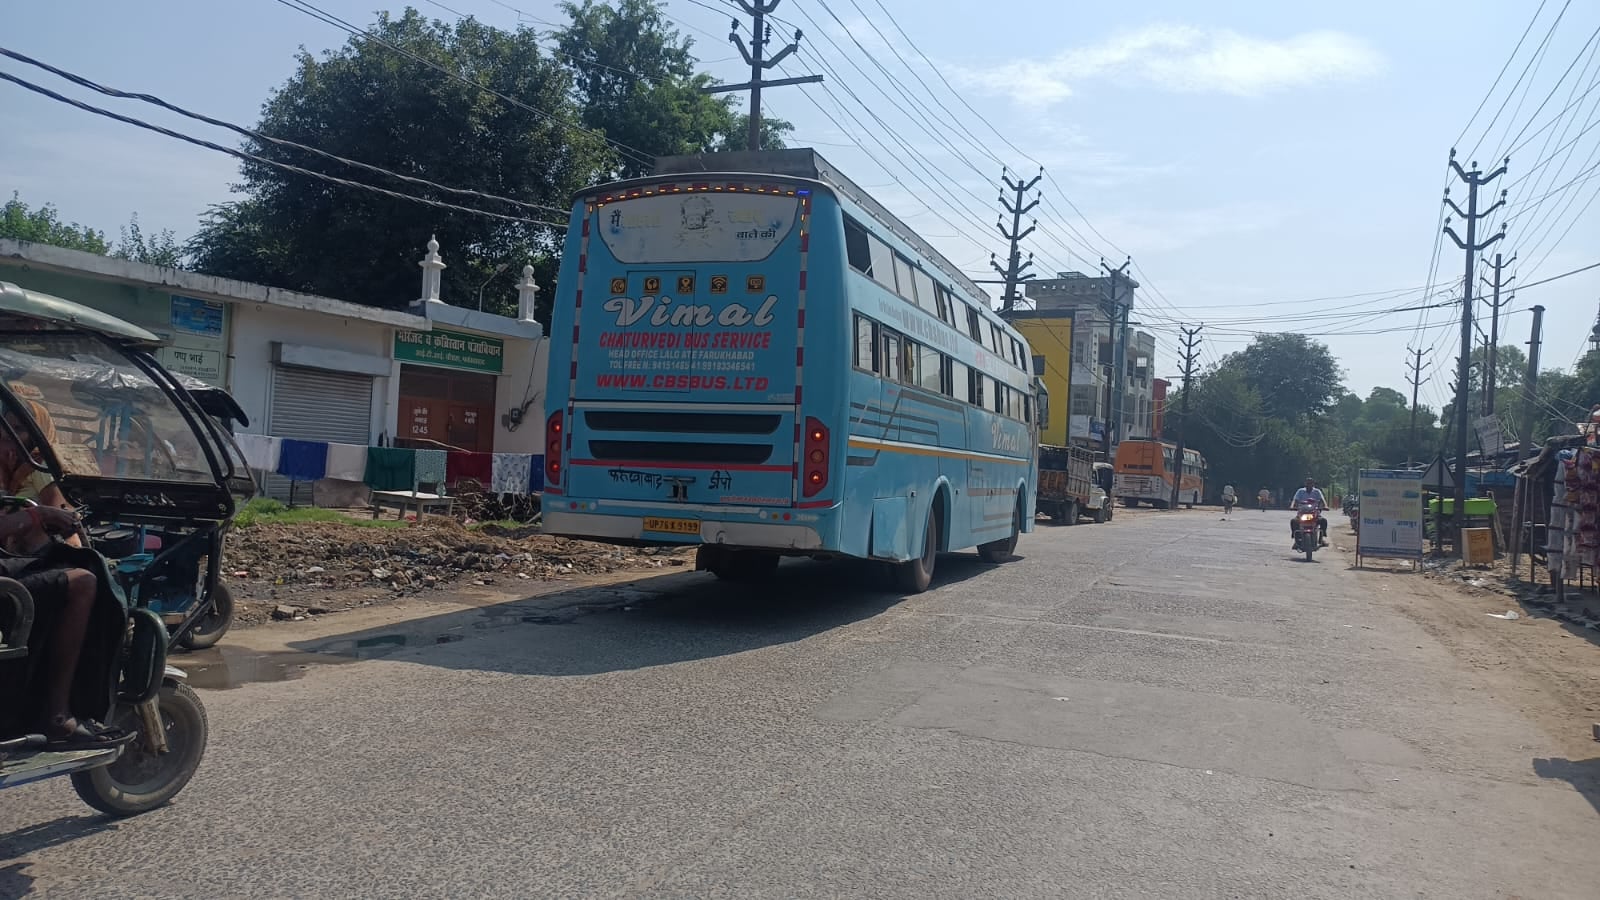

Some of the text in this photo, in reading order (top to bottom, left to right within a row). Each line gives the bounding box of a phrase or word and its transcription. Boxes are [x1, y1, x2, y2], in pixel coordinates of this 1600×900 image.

[603, 295, 778, 326] Vimal
[599, 331, 771, 350] CHATURVEDI BUS SERVICE
[608, 350, 630, 359] HEAD
[631, 350, 658, 360] OFFICE
[698, 351, 755, 360] FARUKHABAD
[609, 360, 623, 370] TOL
[624, 360, 641, 370] FREE
[596, 373, 769, 391] WWW.CBSBUS.LTD
[992, 422, 1021, 451] Vimal
